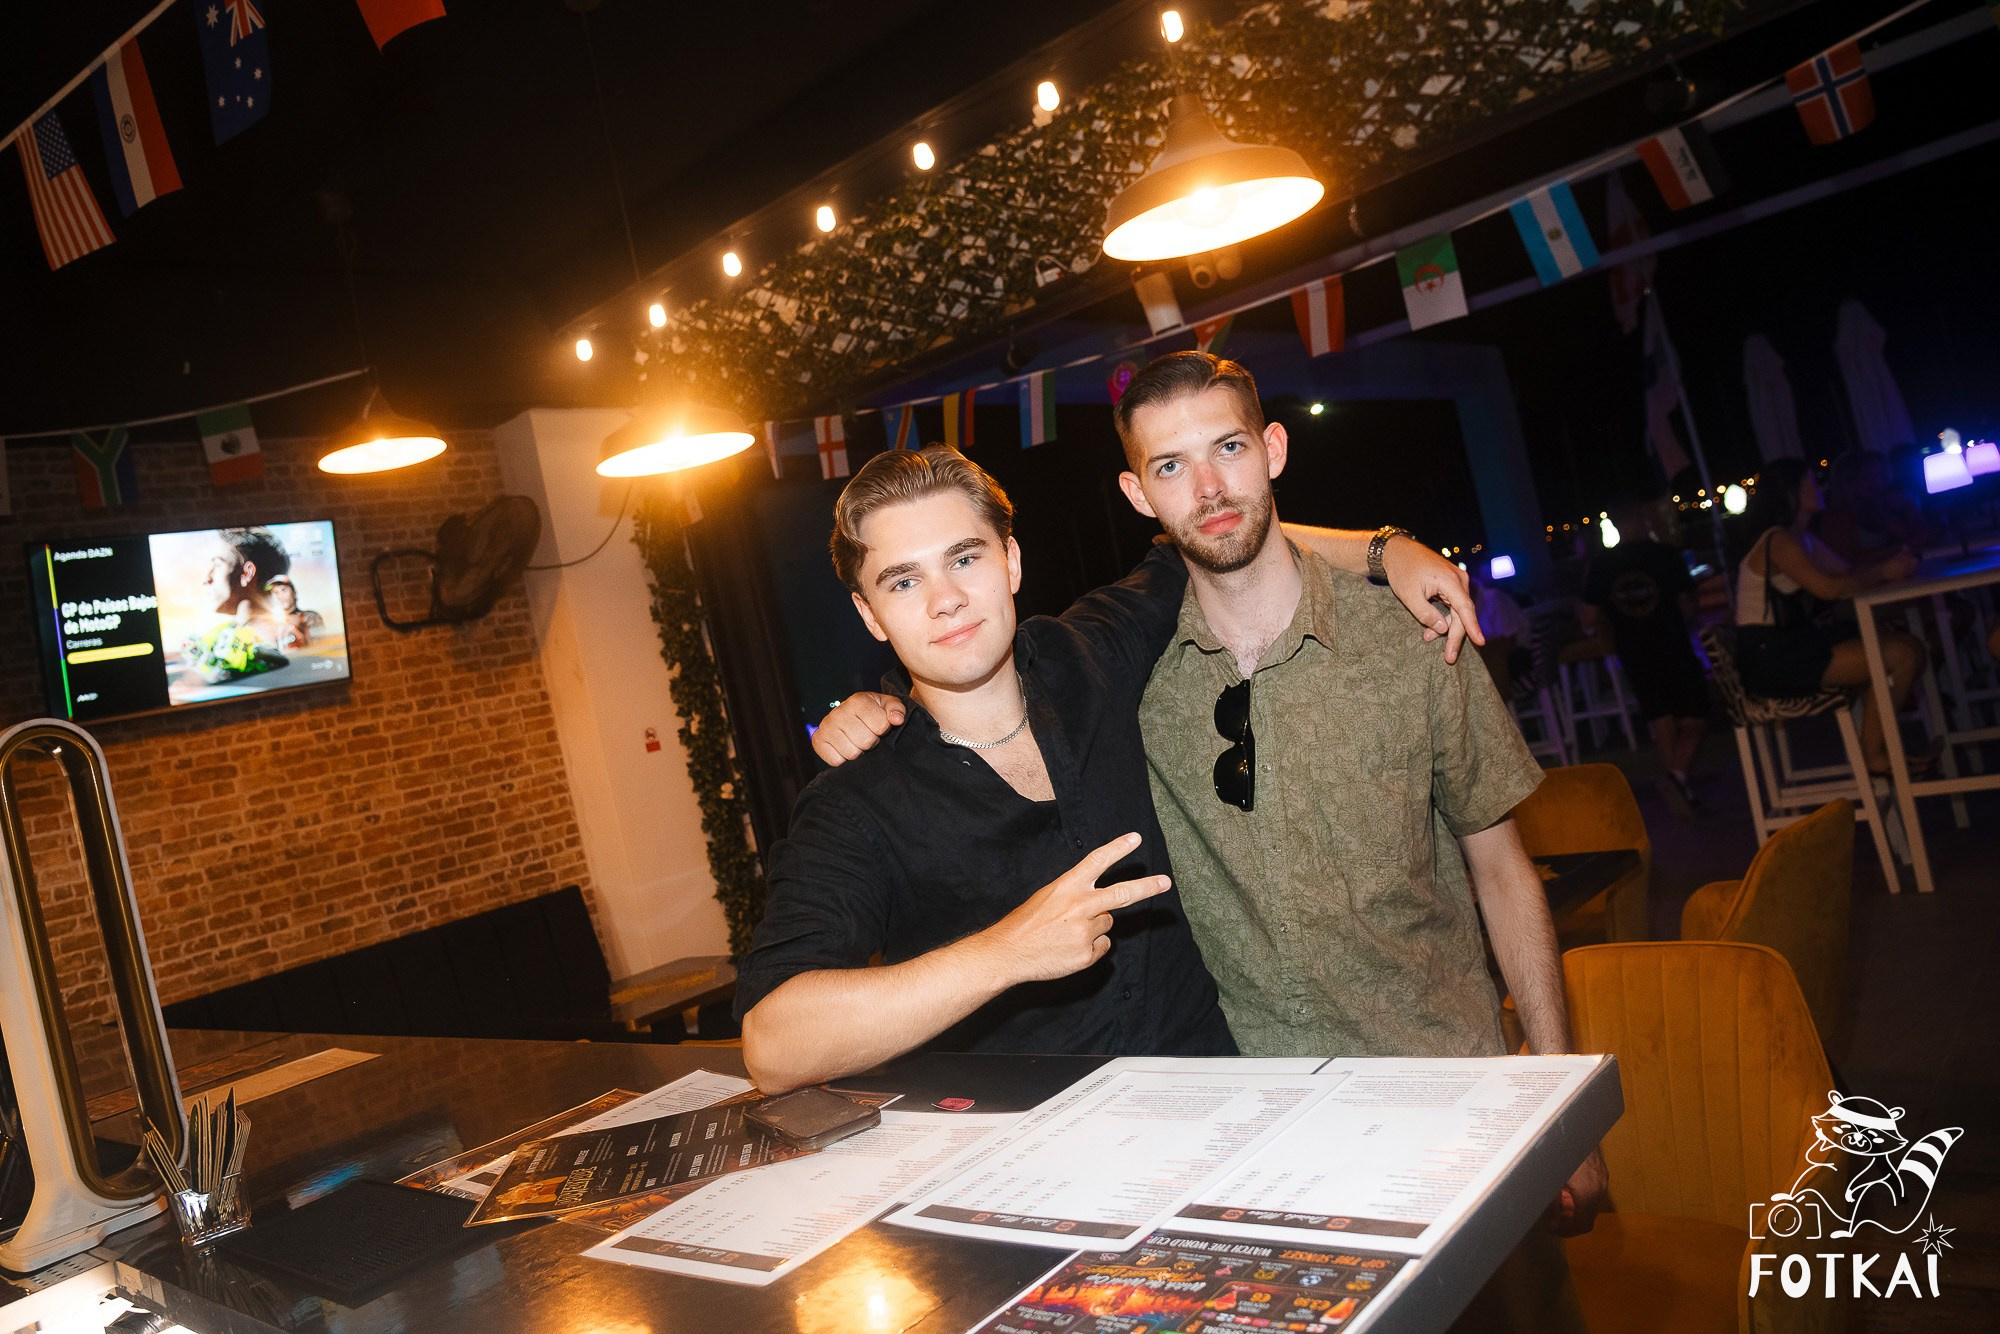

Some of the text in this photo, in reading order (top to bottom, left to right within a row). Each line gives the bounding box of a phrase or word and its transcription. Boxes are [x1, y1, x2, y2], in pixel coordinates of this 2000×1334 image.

[54, 547, 113, 562] Agenda DAZN
[62, 602, 77, 618] GP
[78, 601, 93, 616] de
[128, 594, 158, 612] Bajos
[64, 614, 121, 635] de MotoGP
[66, 638, 103, 649] Carreras
[1170, 1239, 1208, 1249] WORLD
[1210, 1243, 1232, 1251] THE
[1232, 1244, 1273, 1256] WATCH
[1331, 1255, 1360, 1266] THE
[1086, 1273, 1206, 1292] Watch the World Cup
